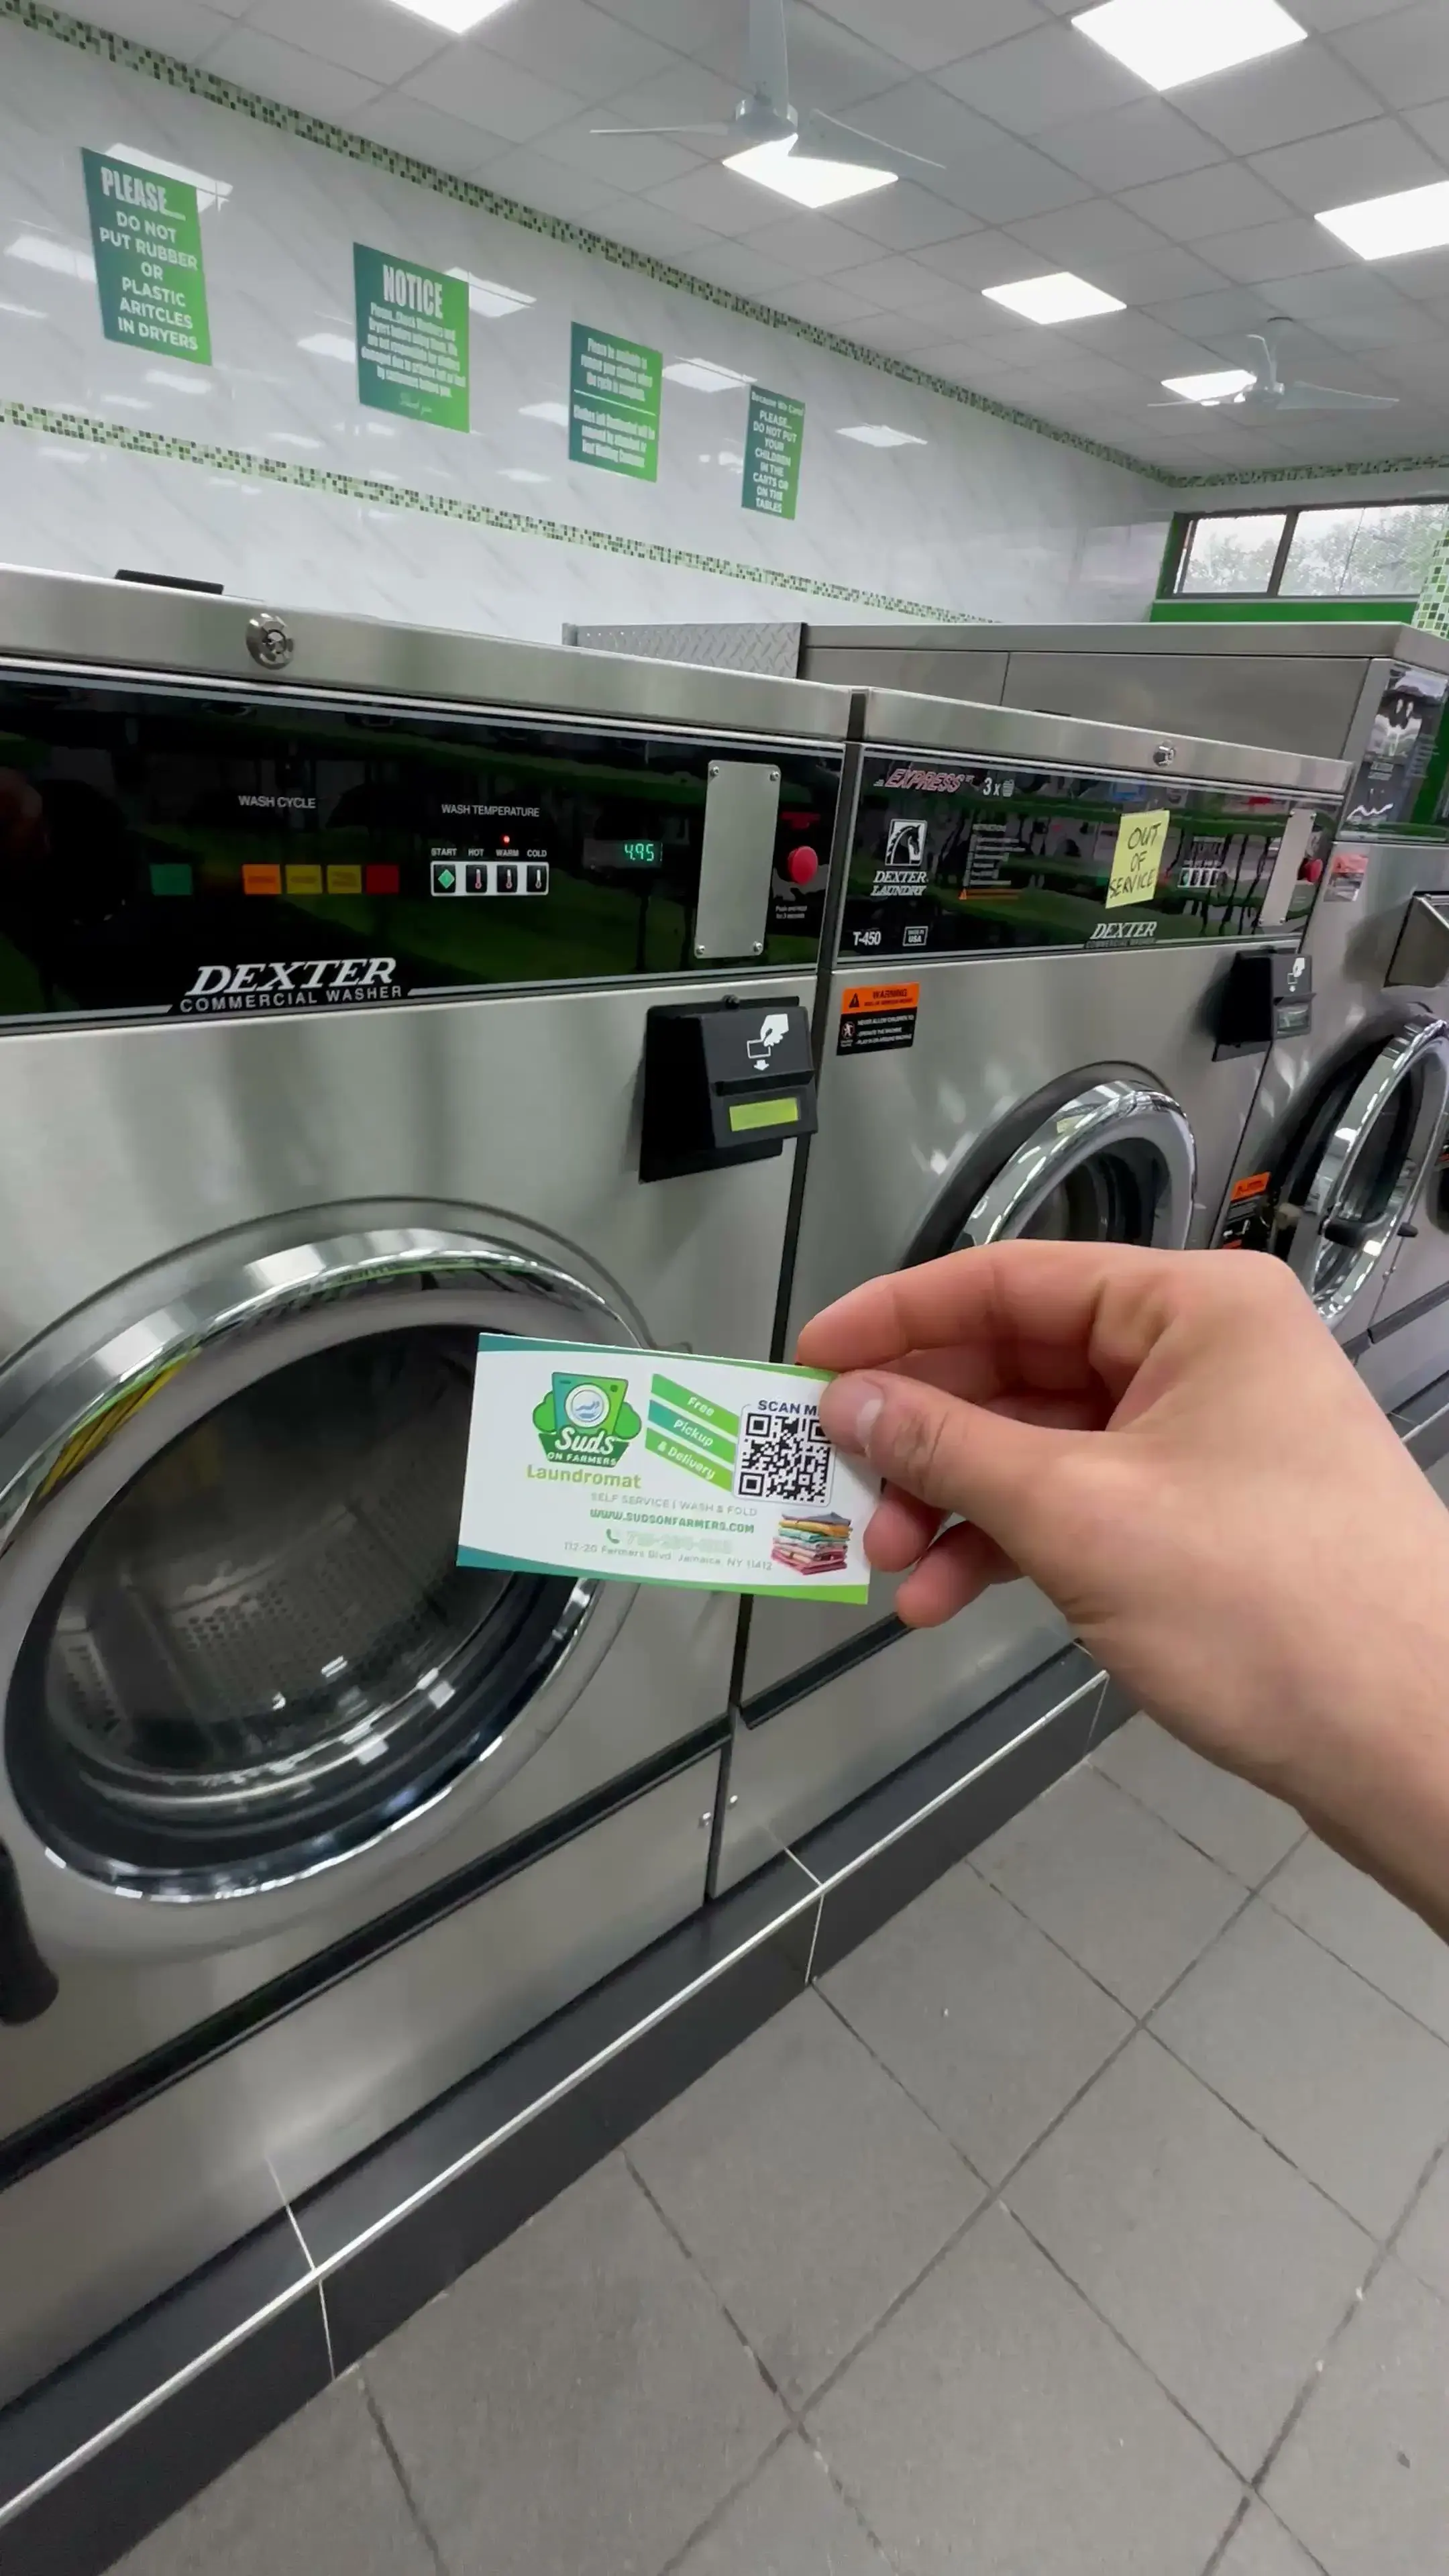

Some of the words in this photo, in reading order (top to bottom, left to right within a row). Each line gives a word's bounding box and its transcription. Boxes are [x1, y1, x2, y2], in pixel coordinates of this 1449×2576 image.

[116, 211, 140, 231] DO
[144, 220, 176, 244] NOT
[99, 227, 131, 250] PUT
[136, 238, 198, 270] RUBBER
[141, 262, 163, 281] OR
[121, 277, 186, 307] PLASTIC
[383, 264, 443, 319] NOTICE
[118, 317, 135, 335] IN
[138, 322, 199, 350] DRYERS
[753, 421, 765, 433] DO
[765, 425, 782, 438] NOT
[782, 431, 797, 443] PUT
[765, 437, 784, 451] YOUR
[755, 447, 792, 467] CHILDREN
[753, 472, 777, 488] CARTS
[756, 486, 768, 498] ON
[885, 768, 965, 793] EXPRESS
[238, 795, 276, 808] WASH
[277, 796, 316, 808] CYCLE
[441, 804, 470, 814] WASH
[472, 805, 540, 817] TEMPERATURE
[1128, 822, 1161, 849] OUT
[431, 847, 457, 857] START
[468, 848, 484, 857] HOT
[496, 849, 519, 857] WARM
[527, 849, 547, 857] COLD
[1130, 851, 1147, 872] OF
[873, 871, 927, 883] DEXTER
[1109, 869, 1156, 899] SERVICE
[871, 885, 927, 896] LAUNDRY
[853, 931, 882, 946] T-450
[908, 935, 922, 943] USA
[1089, 922, 1157, 939] DEXTER
[184, 957, 396, 996] DEXTER
[180, 991, 317, 1012] COMMERCIAL
[326, 985, 401, 1002] WASHER
[687, 1396, 714, 1417] Free
[758, 1399, 800, 1414] SCAN
[804, 1405, 819, 1415] M
[555, 1426, 615, 1455] Suds
[673, 1419, 713, 1446] Pickup
[547, 1451, 563, 1460] ON
[566, 1454, 618, 1466] FARMERS
[657, 1441, 667, 1452] &
[667, 1446, 716, 1480] Delivery
[526, 1464, 642, 1489] Laundromat
[590, 1492, 619, 1503] SELF
[621, 1495, 670, 1509] SERVICE
[680, 1501, 714, 1512] WASH
[727, 1505, 758, 1517] FOLD
[590, 1508, 755, 1534] WWW.SUDSONFARMERS.COM
[727, 1558, 743, 1568] NY
